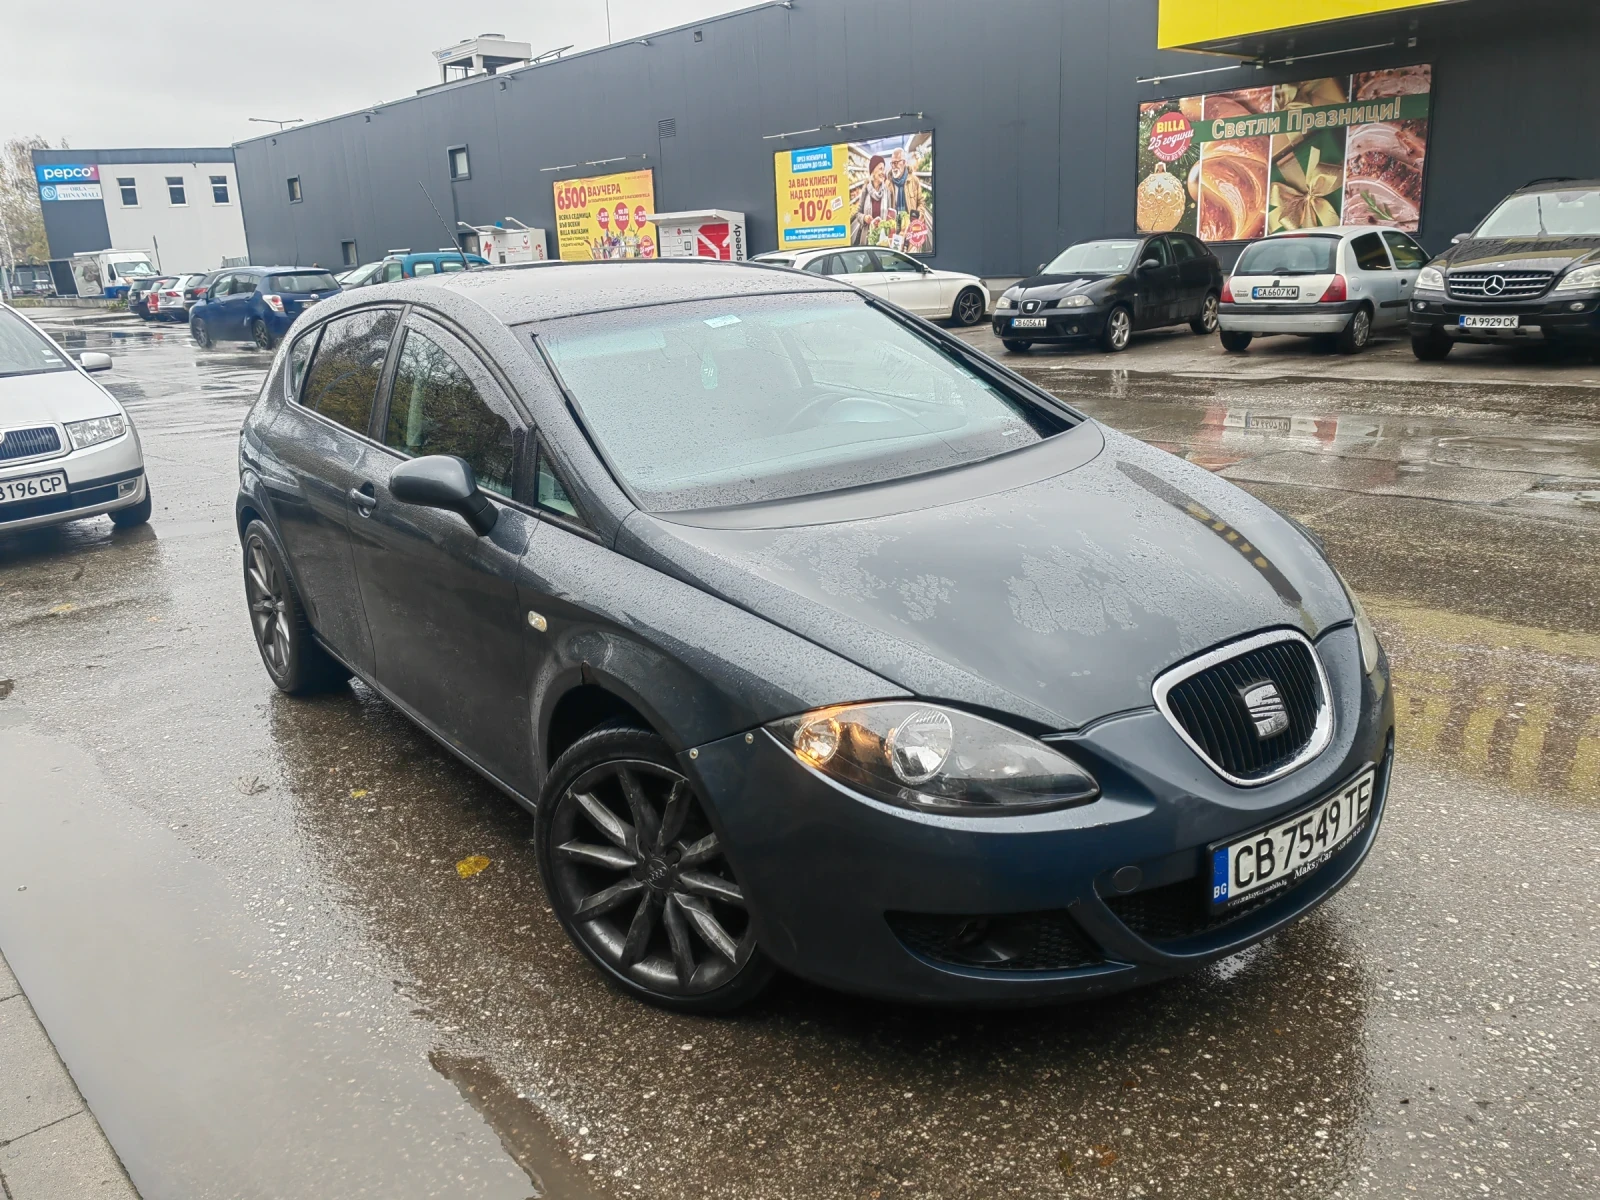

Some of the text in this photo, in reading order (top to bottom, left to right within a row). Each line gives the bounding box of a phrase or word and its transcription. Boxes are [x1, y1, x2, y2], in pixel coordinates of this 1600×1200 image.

[1212, 97, 1401, 139] Светли Празници!
[1156, 120, 1186, 133] BILLA
[1148, 129, 1194, 150] 25 години
[44, 168, 92, 180] pepco
[788, 175, 838, 188] ЗА ВАС КЛИЕНТИ
[557, 186, 587, 210] 6500
[587, 183, 622, 197] ВАУЧЕРА
[790, 187, 836, 200] НАД 65 ГОДИНИ
[794, 199, 832, 222] -10%
[733, 224, 742, 261] speedy
[1286, 288, 1297, 296] KM
[1465, 317, 1516, 326] CA 9929 CK
[40, 477, 61, 493] CP
[1235, 837, 1275, 889] CB
[1282, 801, 1341, 870] 7549
[1345, 778, 1370, 828] TE
[1214, 883, 1227, 899] BG
